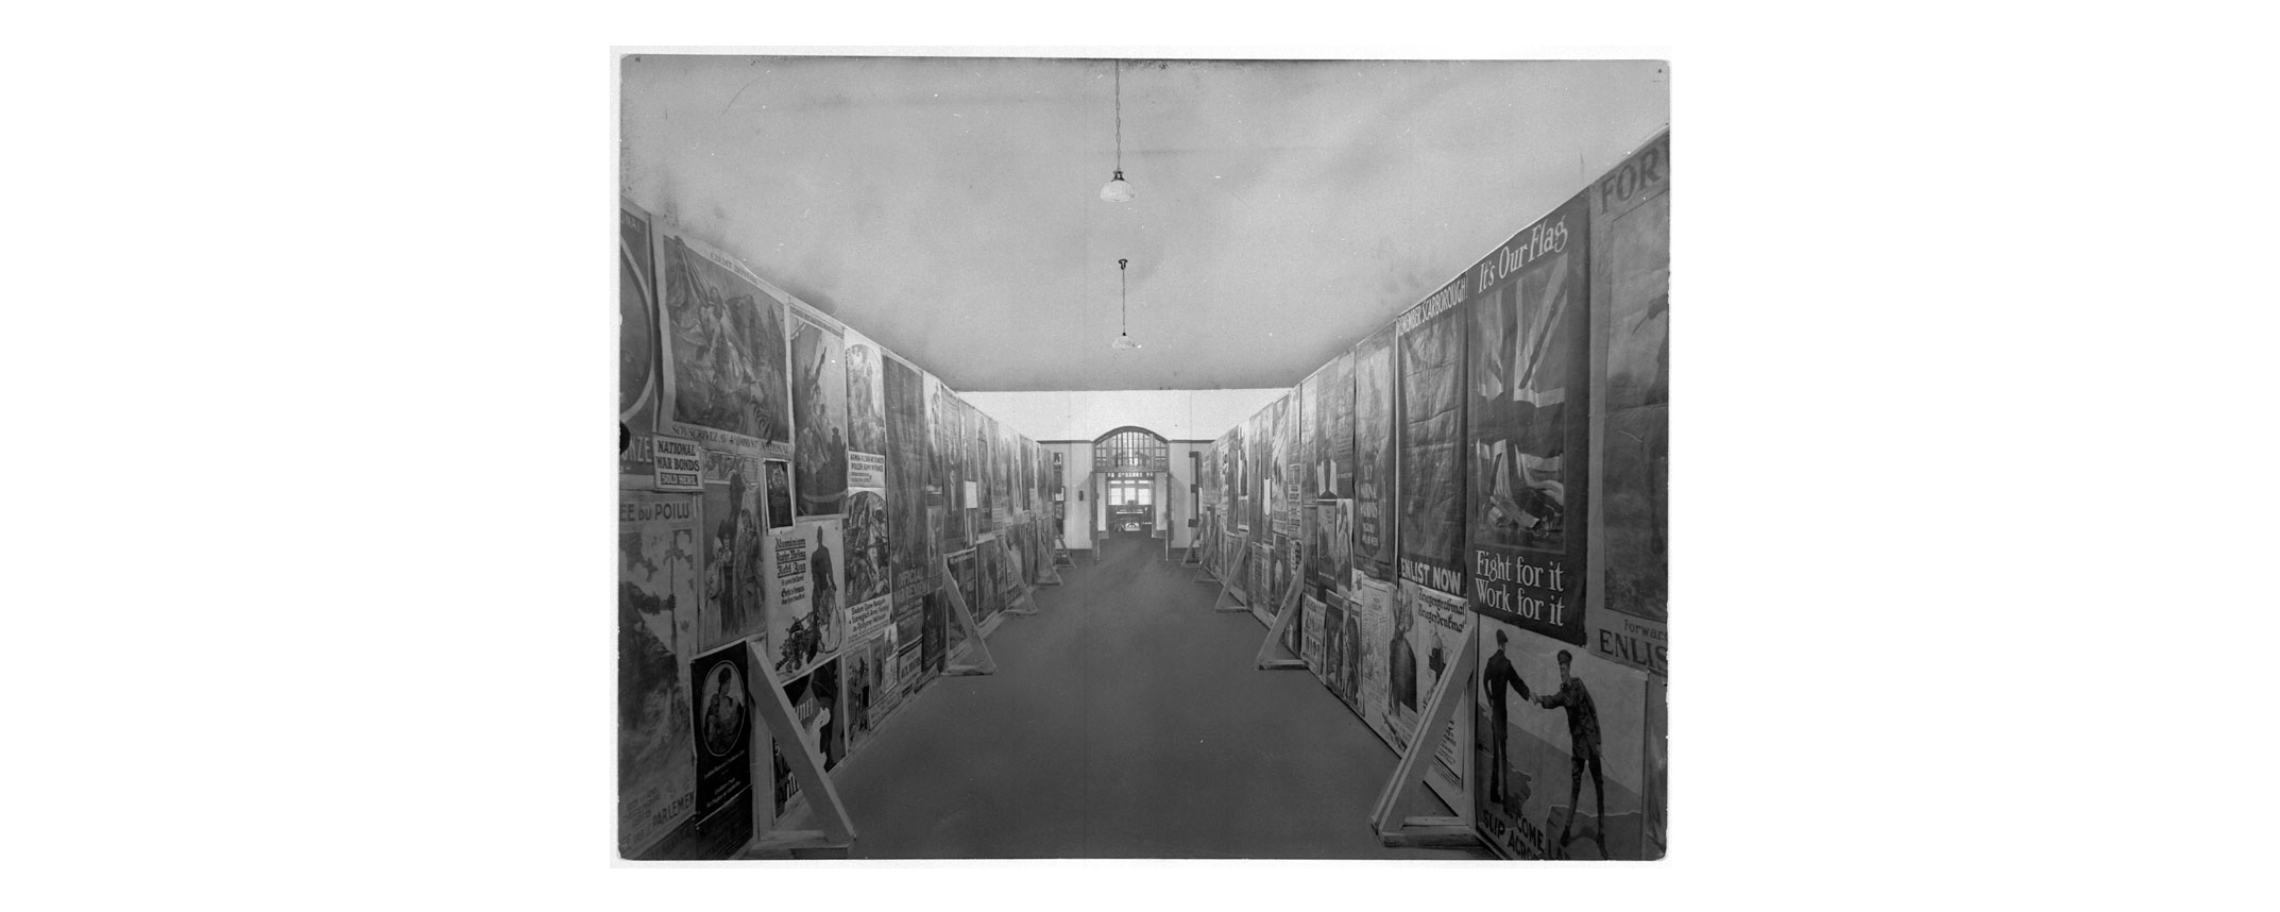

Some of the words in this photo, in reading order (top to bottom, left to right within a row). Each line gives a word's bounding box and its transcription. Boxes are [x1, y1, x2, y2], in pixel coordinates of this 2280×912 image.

[1478, 260, 1496, 294] It's
[1498, 244, 1528, 280] Our
[1528, 214, 1568, 262] Flag
[656, 456, 673, 469] WAR
[674, 458, 700, 472] BONDS
[657, 440, 696, 456] NATIONAL
[661, 474, 678, 484] SOLD
[679, 475, 697, 485] HERE
[1401, 557, 1430, 586] ENLIST
[1433, 566, 1461, 595] NOW
[1476, 549, 1512, 582] Fight
[1516, 556, 1544, 588] for
[1549, 561, 1564, 592] it
[1475, 577, 1513, 612] Work
[1516, 587, 1544, 620] for
[1549, 595, 1565, 626] it
[1624, 618, 1668, 642] Forwar
[1483, 809, 1505, 839] SLIP
[1508, 830, 1539, 860] ACRO
